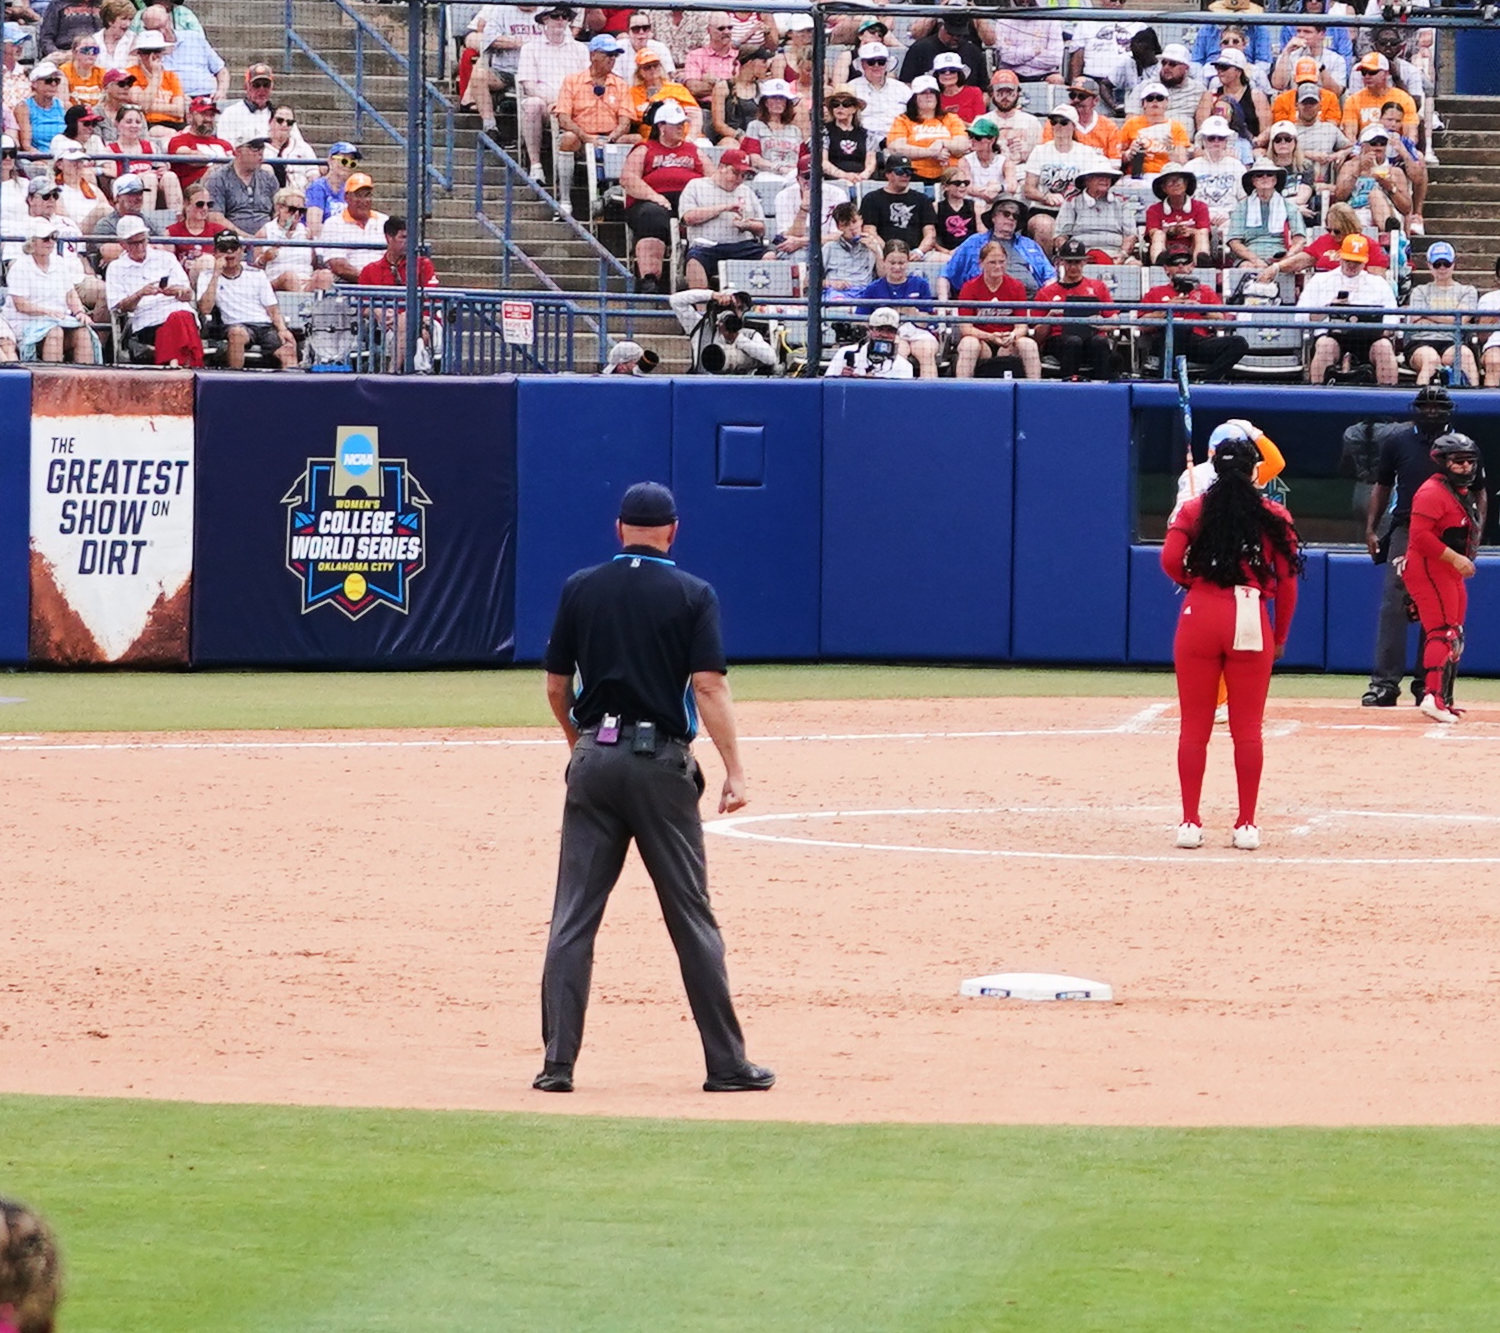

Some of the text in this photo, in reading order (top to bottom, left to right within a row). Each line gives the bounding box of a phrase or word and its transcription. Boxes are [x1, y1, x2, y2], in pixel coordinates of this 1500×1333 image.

[50, 437, 76, 454] THE
[343, 453, 374, 466] NCAA
[46, 459, 190, 495] GREATEST
[335, 499, 381, 509] WOMEN'S
[59, 499, 171, 535] SHOW ON
[318, 511, 396, 535] COLLEGE
[78, 539, 148, 575] DIRT
[291, 536, 421, 560] WORLD SERIES
[317, 561, 395, 572] OKLAHOMA CITY
